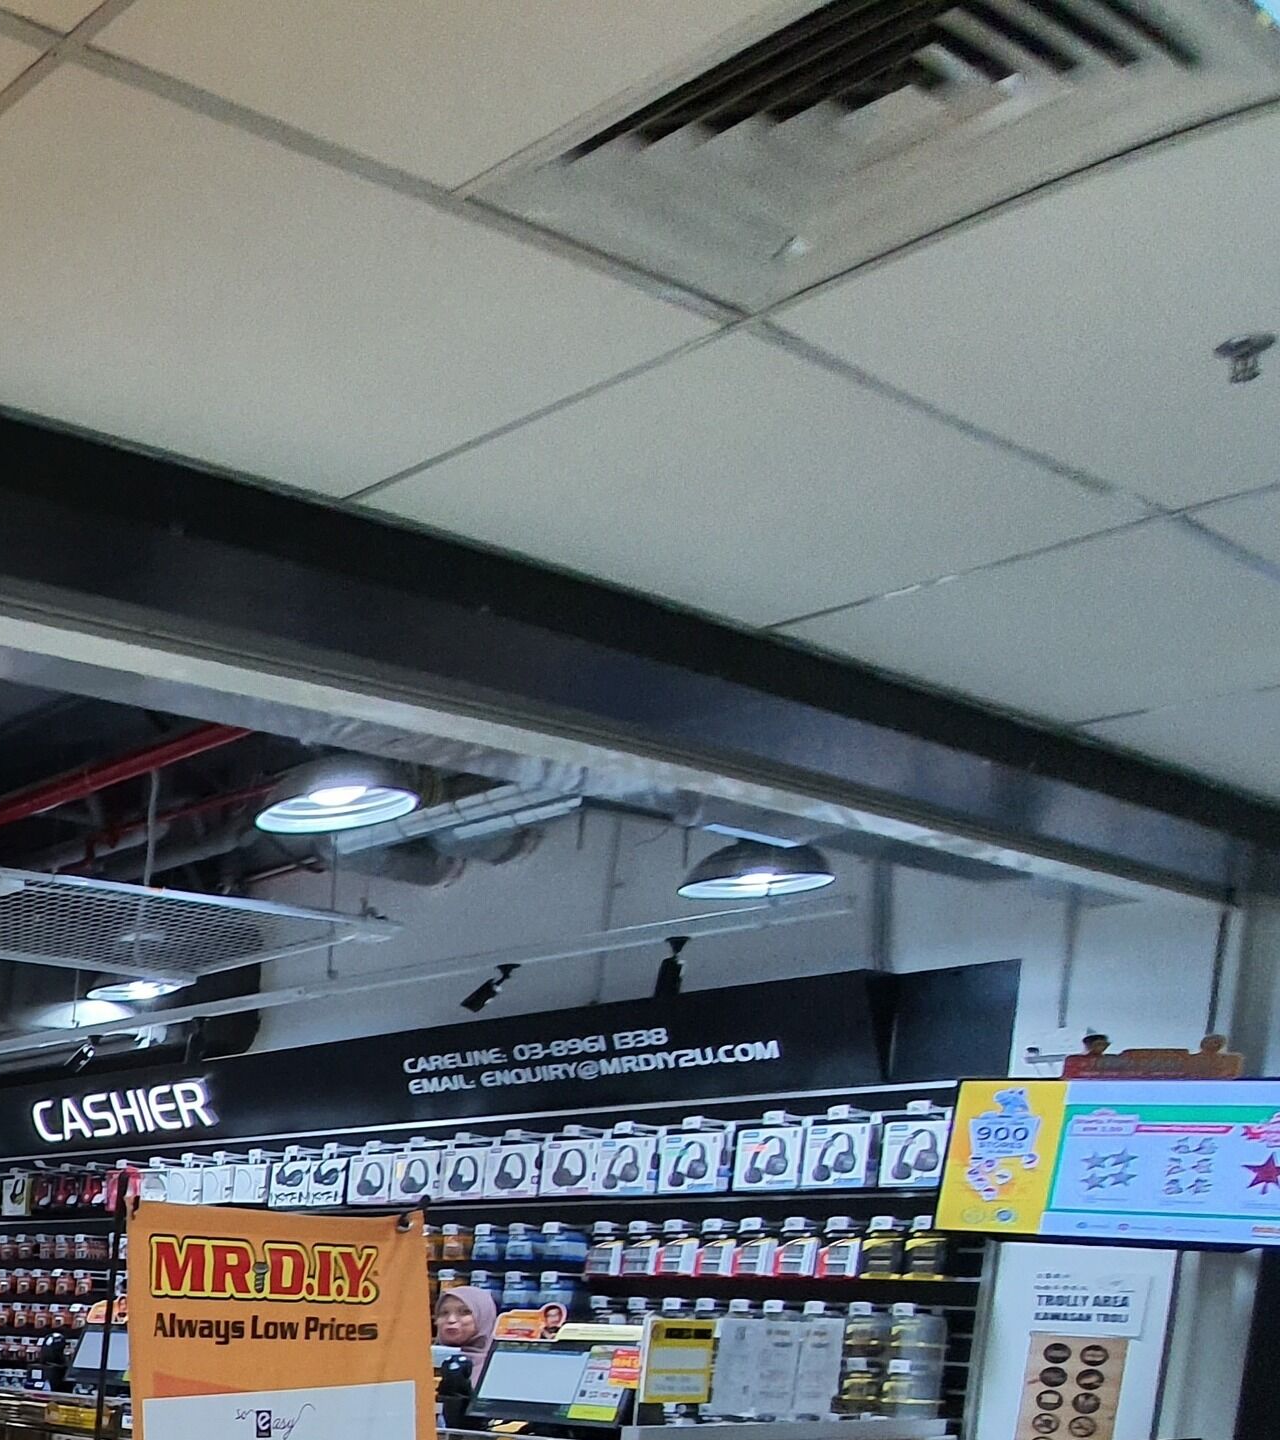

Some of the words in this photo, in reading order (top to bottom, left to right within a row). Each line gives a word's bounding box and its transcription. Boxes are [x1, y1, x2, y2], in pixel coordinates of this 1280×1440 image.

[479, 1039, 781, 1088] ENQUIRY@MRDIY2U.COM
[512, 1034, 607, 1062] 03-8961
[31, 1081, 218, 1143] CASHIER
[976, 1126, 1030, 1141] 900
[153, 1312, 245, 1346] Always
[250, 1314, 299, 1341] Low
[303, 1316, 379, 1342] Prices
